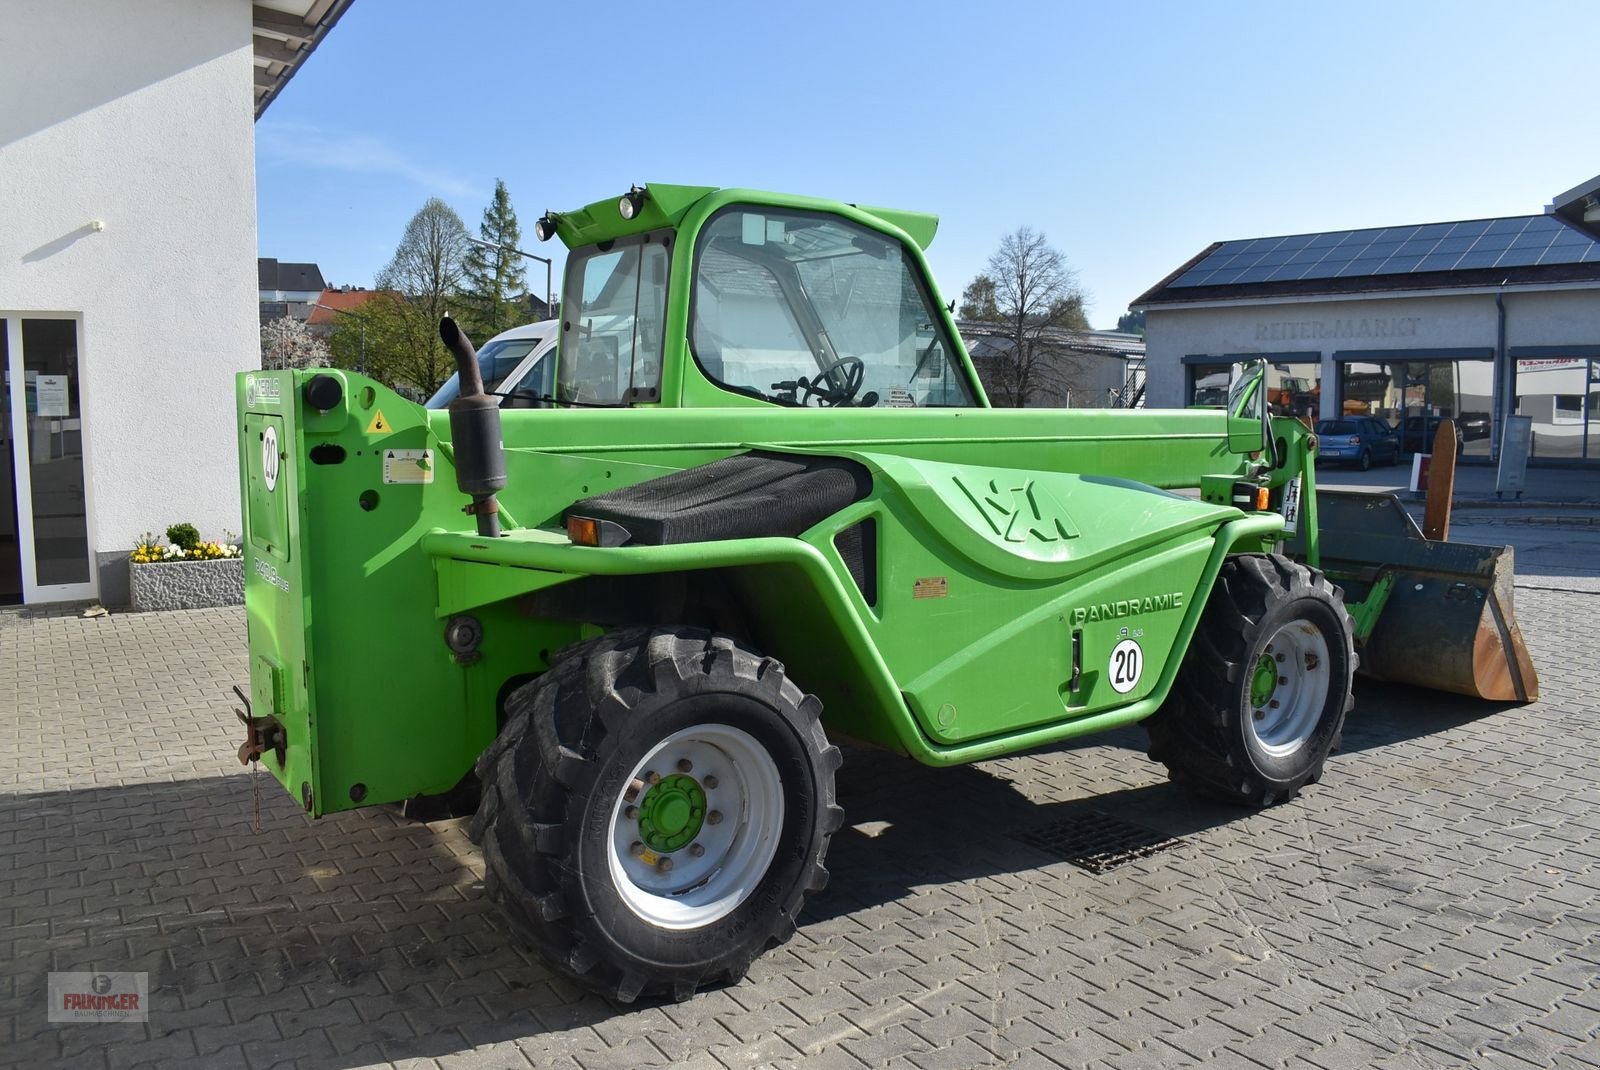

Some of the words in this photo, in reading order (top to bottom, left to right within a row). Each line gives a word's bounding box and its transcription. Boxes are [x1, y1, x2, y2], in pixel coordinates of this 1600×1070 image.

[265, 436, 276, 480] 20
[1072, 592, 1183, 626] PANORAMIC
[1115, 648, 1137, 684] 20
